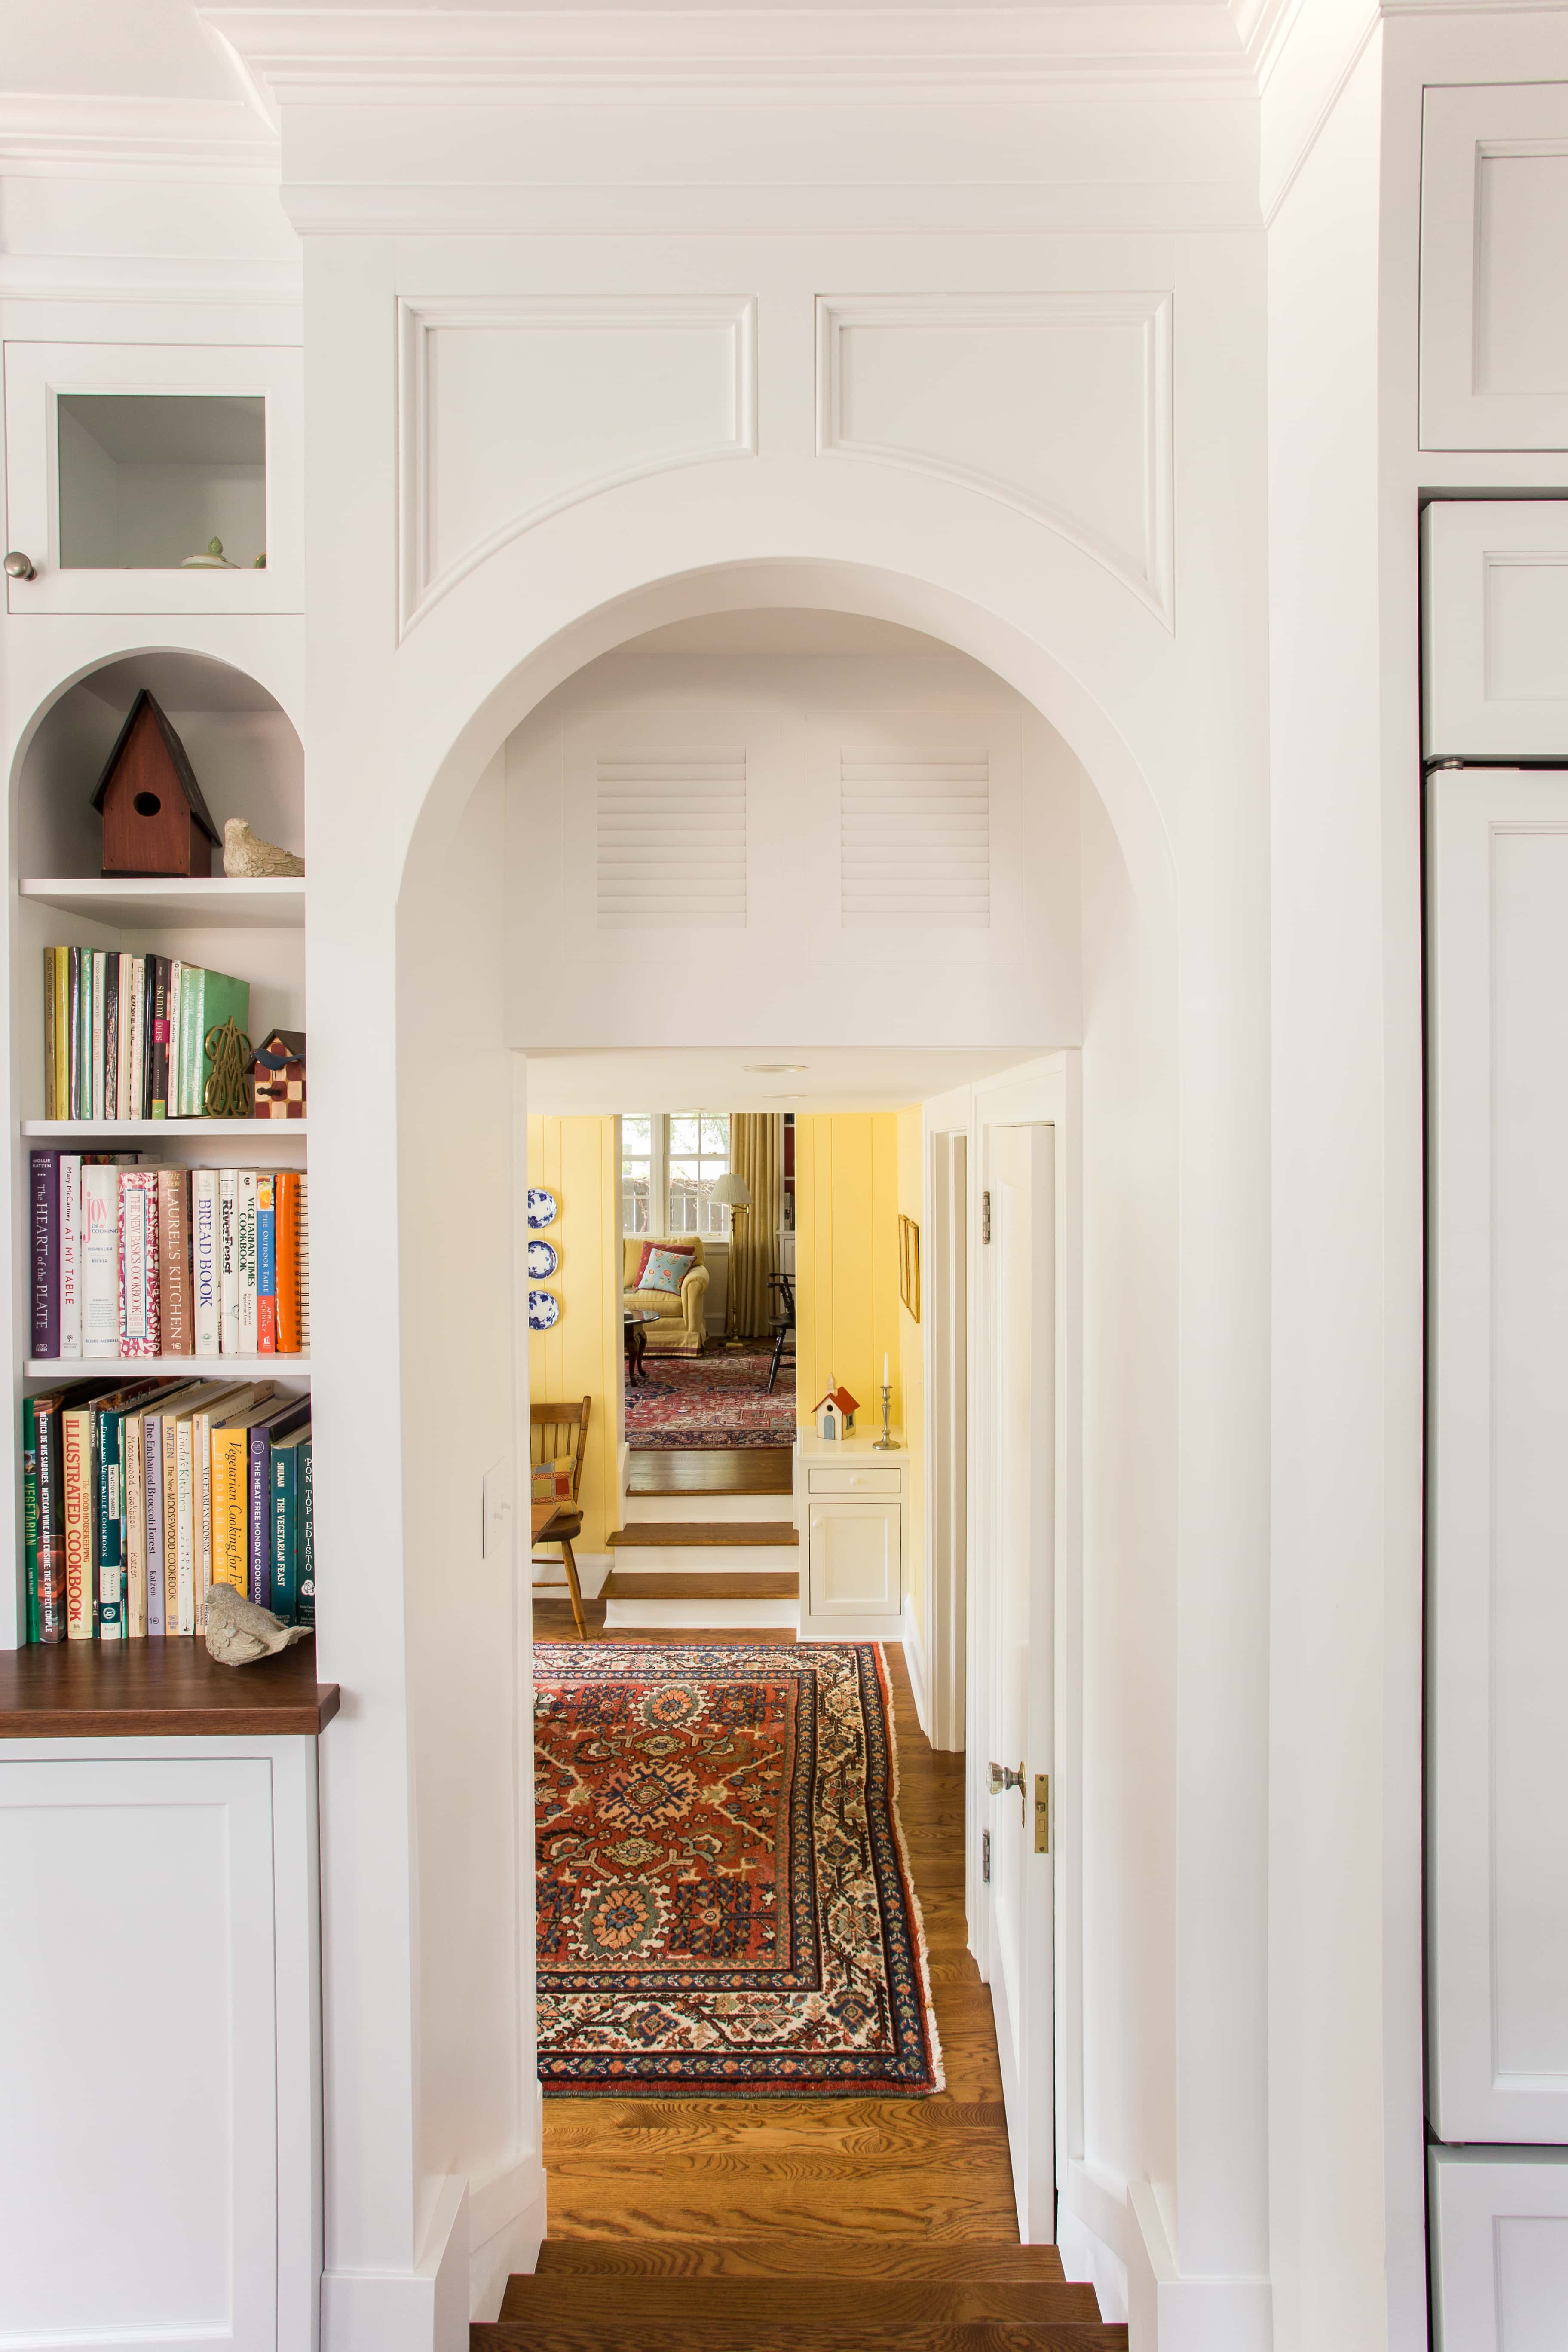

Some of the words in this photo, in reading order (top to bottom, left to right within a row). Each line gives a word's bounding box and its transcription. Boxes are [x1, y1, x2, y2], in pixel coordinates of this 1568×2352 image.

[83, 1191, 114, 1243] joy
[130, 1195, 140, 1212] THE
[36, 1203, 48, 1255] HEART
[65, 1228, 74, 1241] AT
[130, 1215, 141, 1234] NEW
[168, 1188, 181, 1260] LAUREL'S
[199, 1198, 212, 1255] BREAD
[239, 1213, 247, 1272] COOKBOOK
[37, 1256, 46, 1266] of
[65, 1247, 74, 1263] MY
[130, 1235, 141, 1264] BASICS
[37, 1268, 47, 1282] the
[65, 1269, 74, 1304] TABLE
[131, 1266, 141, 1313] COOKBOOK
[199, 1259, 213, 1308] BOOK
[247, 1259, 255, 1287] TIMES
[36, 1285, 48, 1329] PLATE
[169, 1266, 182, 1338] KITCHEN
[40, 1411, 48, 1434] MÉXICO
[40, 1435, 47, 1443] DE
[146, 1422, 155, 1439] The
[166, 1427, 174, 1458] KATZEN
[127, 1436, 136, 1485] Moosewood
[147, 1440, 155, 1485] Enchanted
[178, 1430, 190, 1467] Linda's
[66, 1419, 81, 1525] ILLUSTRATED
[179, 1470, 190, 1512] Kitchen
[225, 1441, 242, 1501] Vegetarian
[277, 1462, 285, 1487] SHULMAN
[25, 1482, 36, 1546] VEGETARIAN
[129, 1490, 138, 1529] Cookbook
[148, 1488, 156, 1525] Broccoli
[167, 1493, 176, 1550] MOOSEWOOD
[277, 1498, 285, 1513] THE
[148, 1528, 156, 1554] Forest
[225, 1505, 242, 1551] Cooking
[277, 1515, 285, 1562] VEGETARIAN
[68, 1529, 82, 1622] COOKBOOK
[168, 1553, 176, 1600] COOKBOOK
[225, 1551, 242, 1571] for
